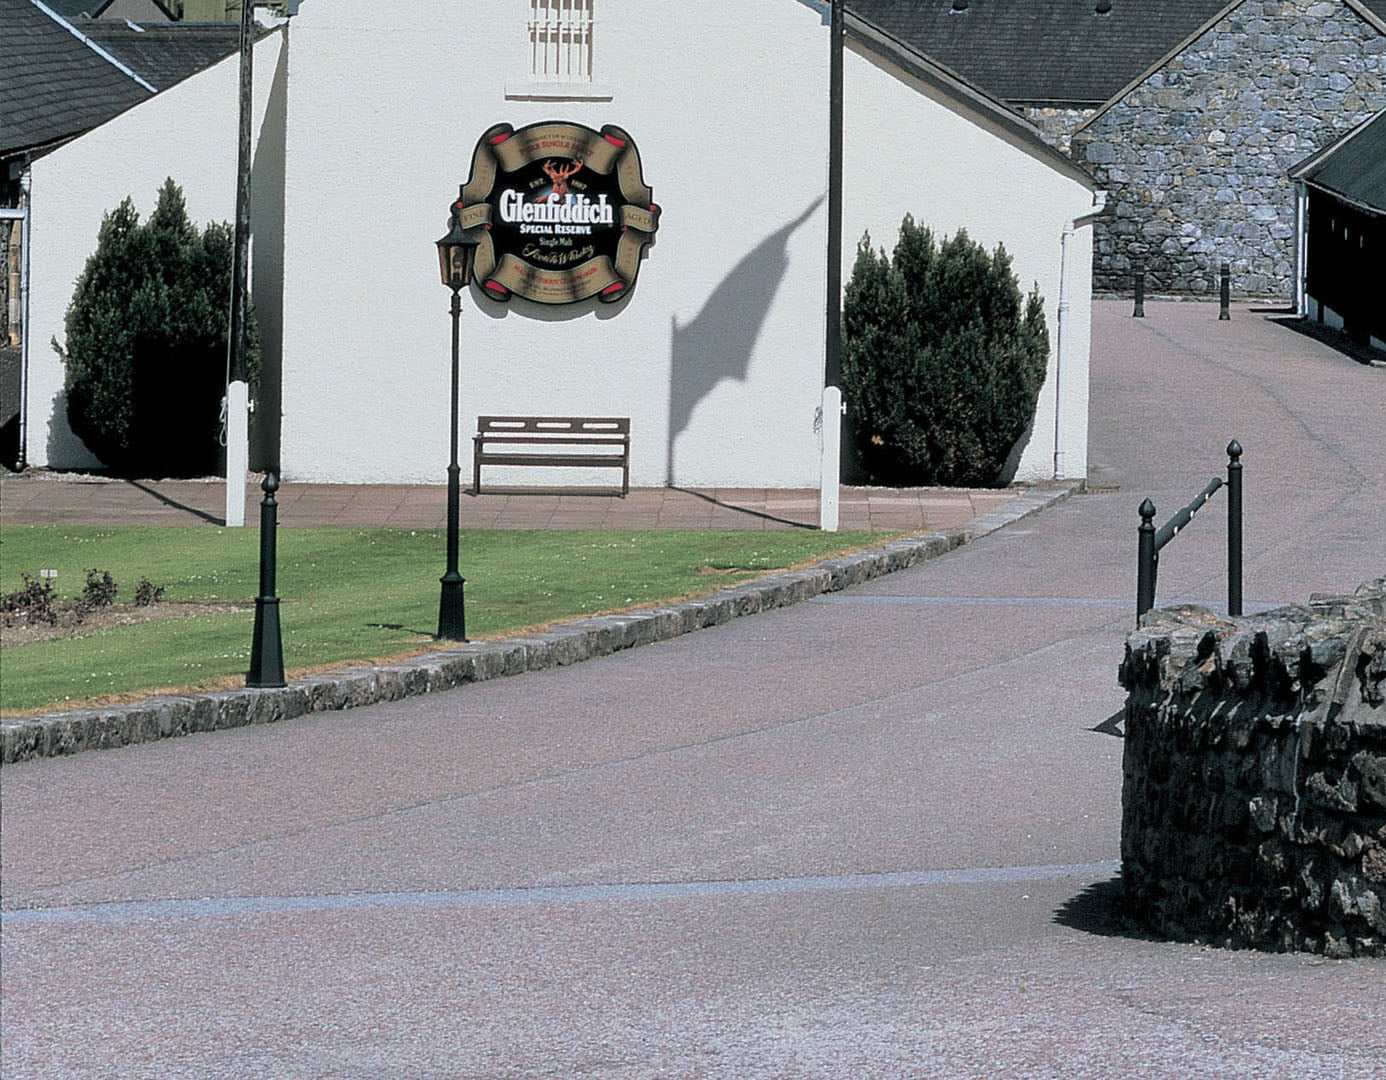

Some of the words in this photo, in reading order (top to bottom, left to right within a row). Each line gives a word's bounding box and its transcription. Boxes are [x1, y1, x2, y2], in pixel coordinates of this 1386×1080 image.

[499, 188, 614, 224] Glenfiddich
[520, 223, 553, 234] SPECIAL
[555, 224, 592, 235] RESERVE
